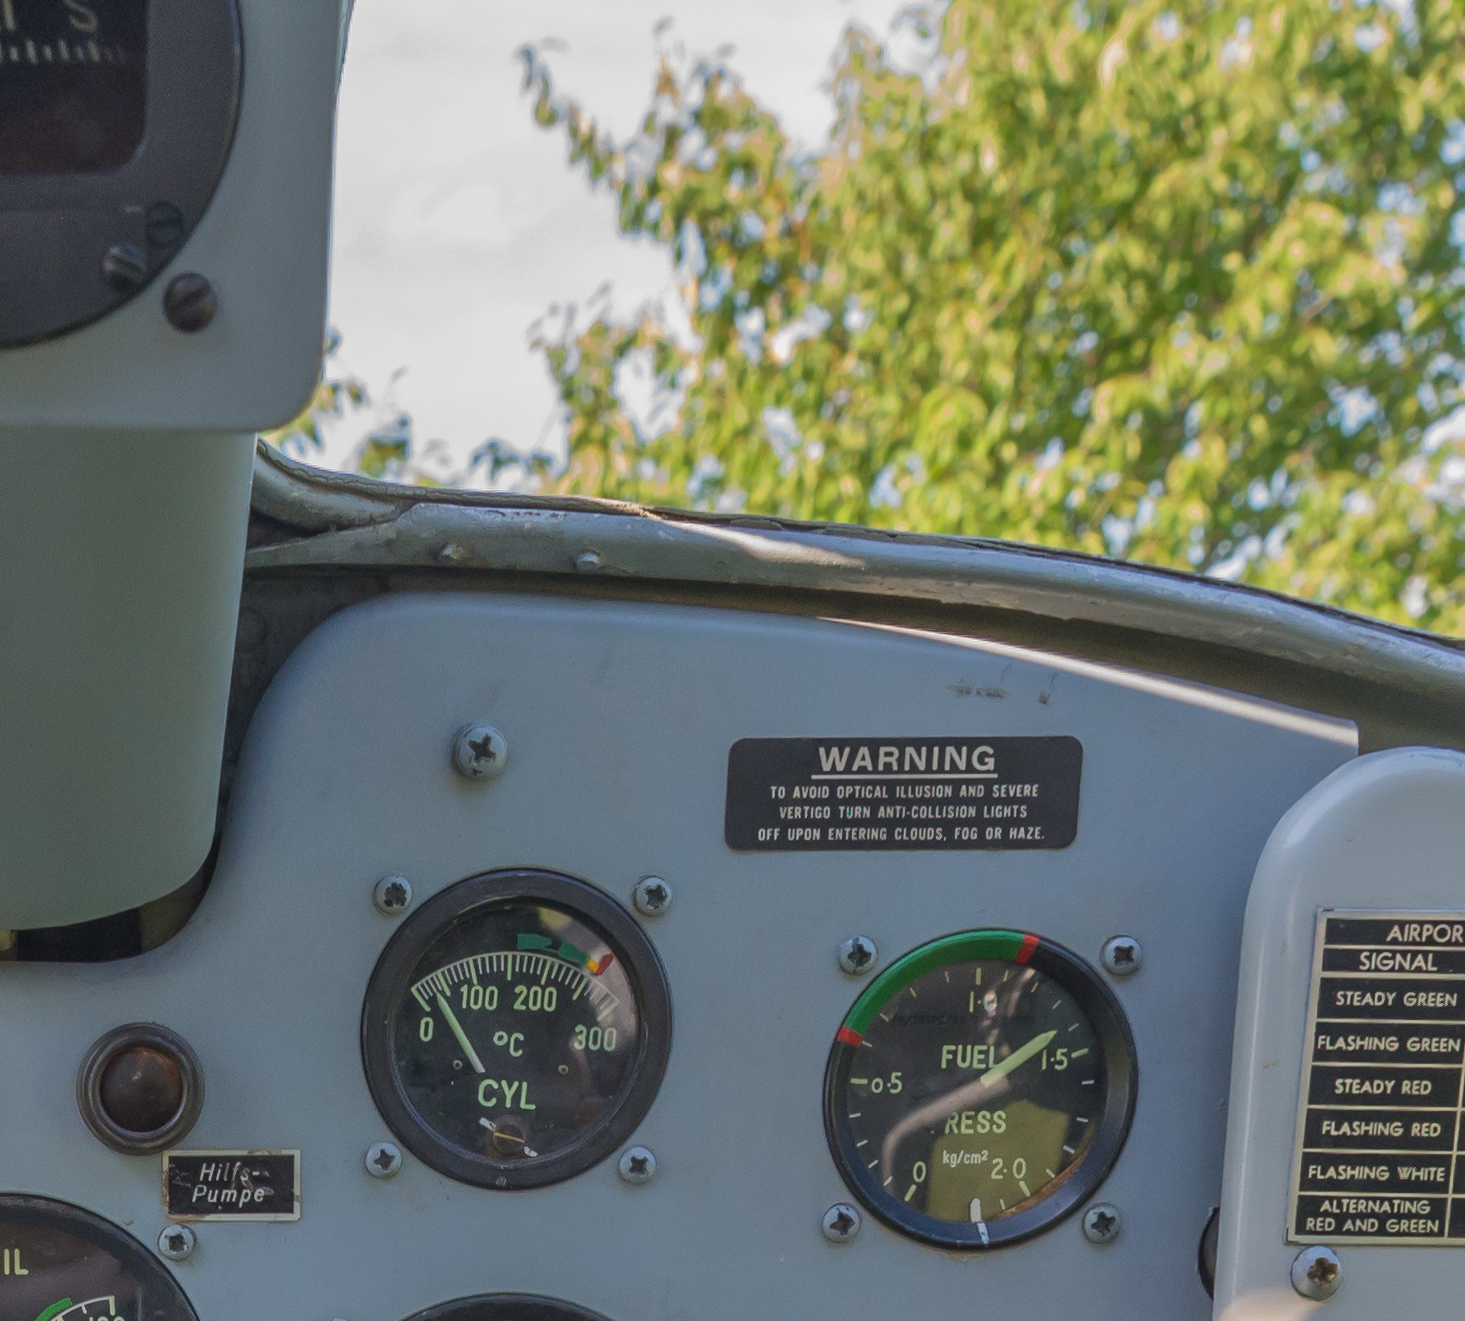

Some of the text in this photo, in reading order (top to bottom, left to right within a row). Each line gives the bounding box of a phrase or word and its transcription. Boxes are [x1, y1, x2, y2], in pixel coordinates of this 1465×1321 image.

[818, 746, 995, 772] WARNING
[770, 784, 1038, 798] TO AVOID OPTICAL ILLUSION AND SEVERE
[780, 805, 1027, 820] VERTIGO TURN ANTI-COLLISION LIGHTS
[758, 827, 1045, 841] OFF UPON ENTERING CLOUDS, FOG OR HAZE.
[1359, 953, 1437, 972] SIGNAL
[514, 985, 557, 1011] 200
[1336, 991, 1457, 1008] STEADY GREEN
[574, 1024, 616, 1051] 300
[940, 1045, 1000, 1069] FUEL
[478, 1079, 536, 1110] CYL
